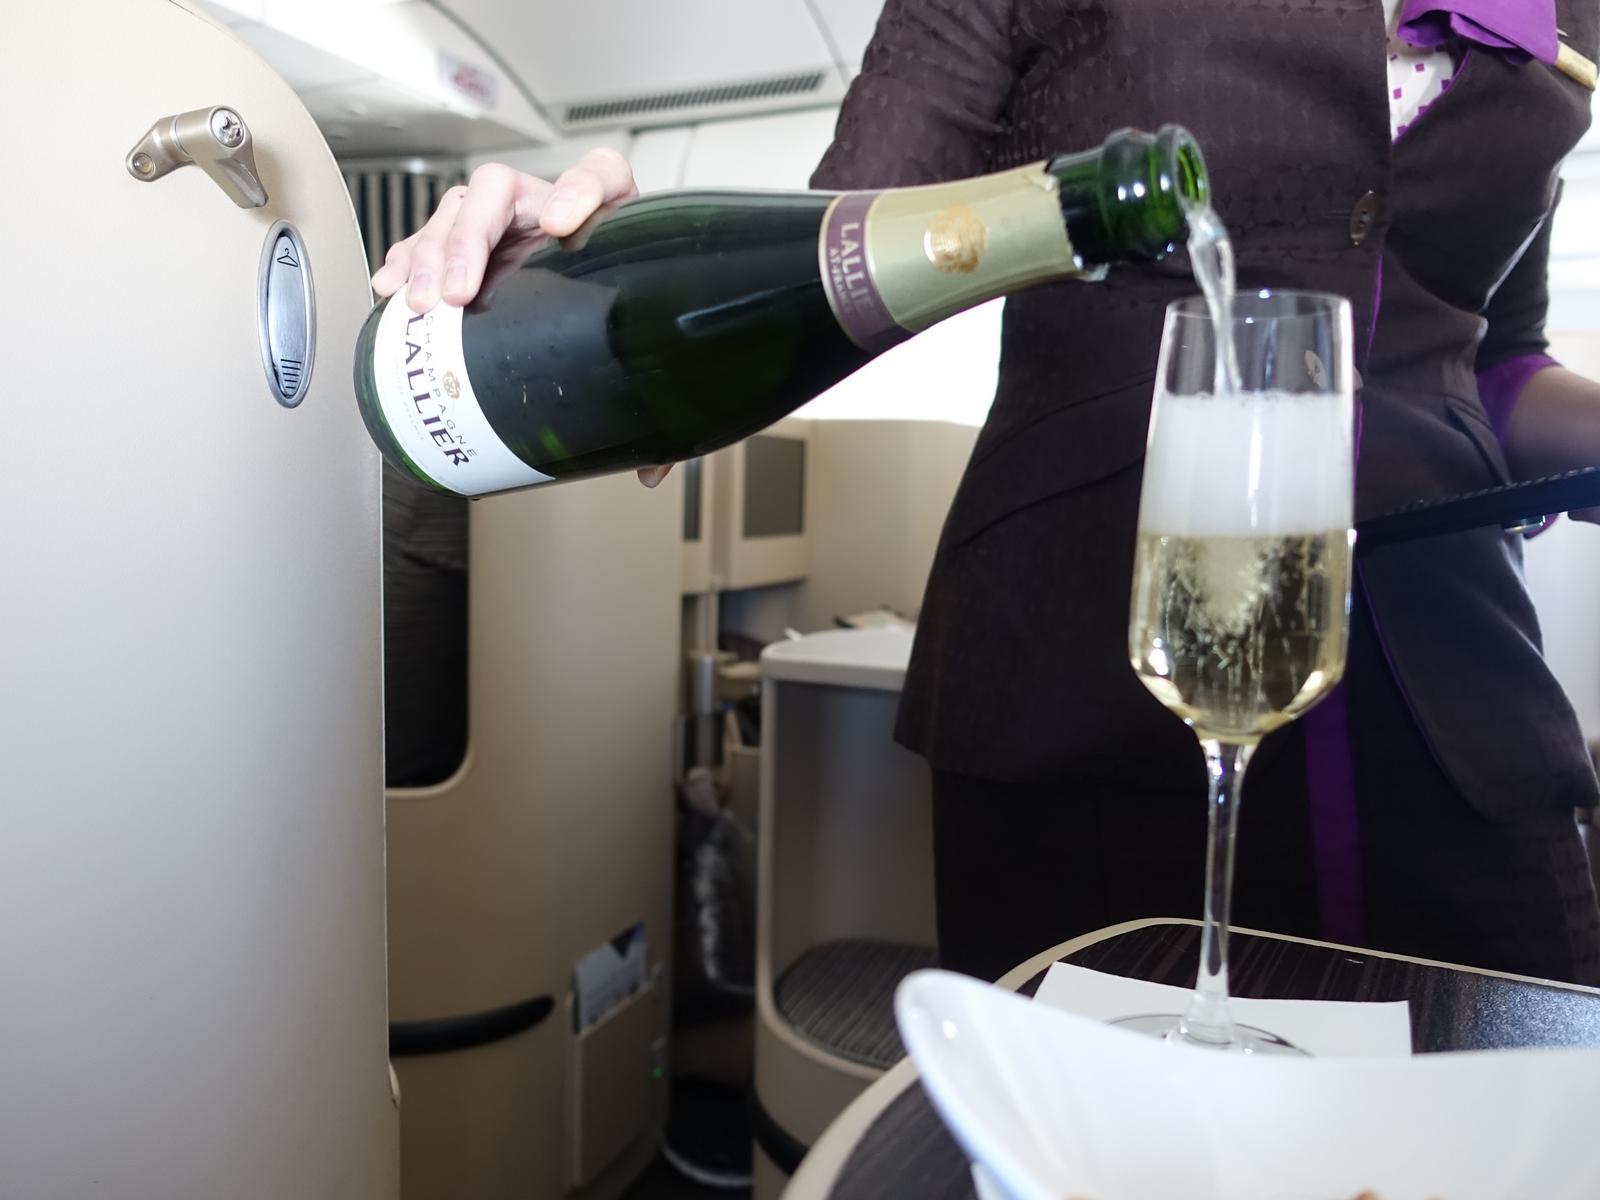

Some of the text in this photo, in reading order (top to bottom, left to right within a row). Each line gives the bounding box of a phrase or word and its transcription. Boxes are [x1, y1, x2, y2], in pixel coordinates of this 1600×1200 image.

[841, 222, 875, 312] LALLIE
[405, 313, 470, 467] LALLIER
[424, 315, 478, 457] CHAMPAGNE
